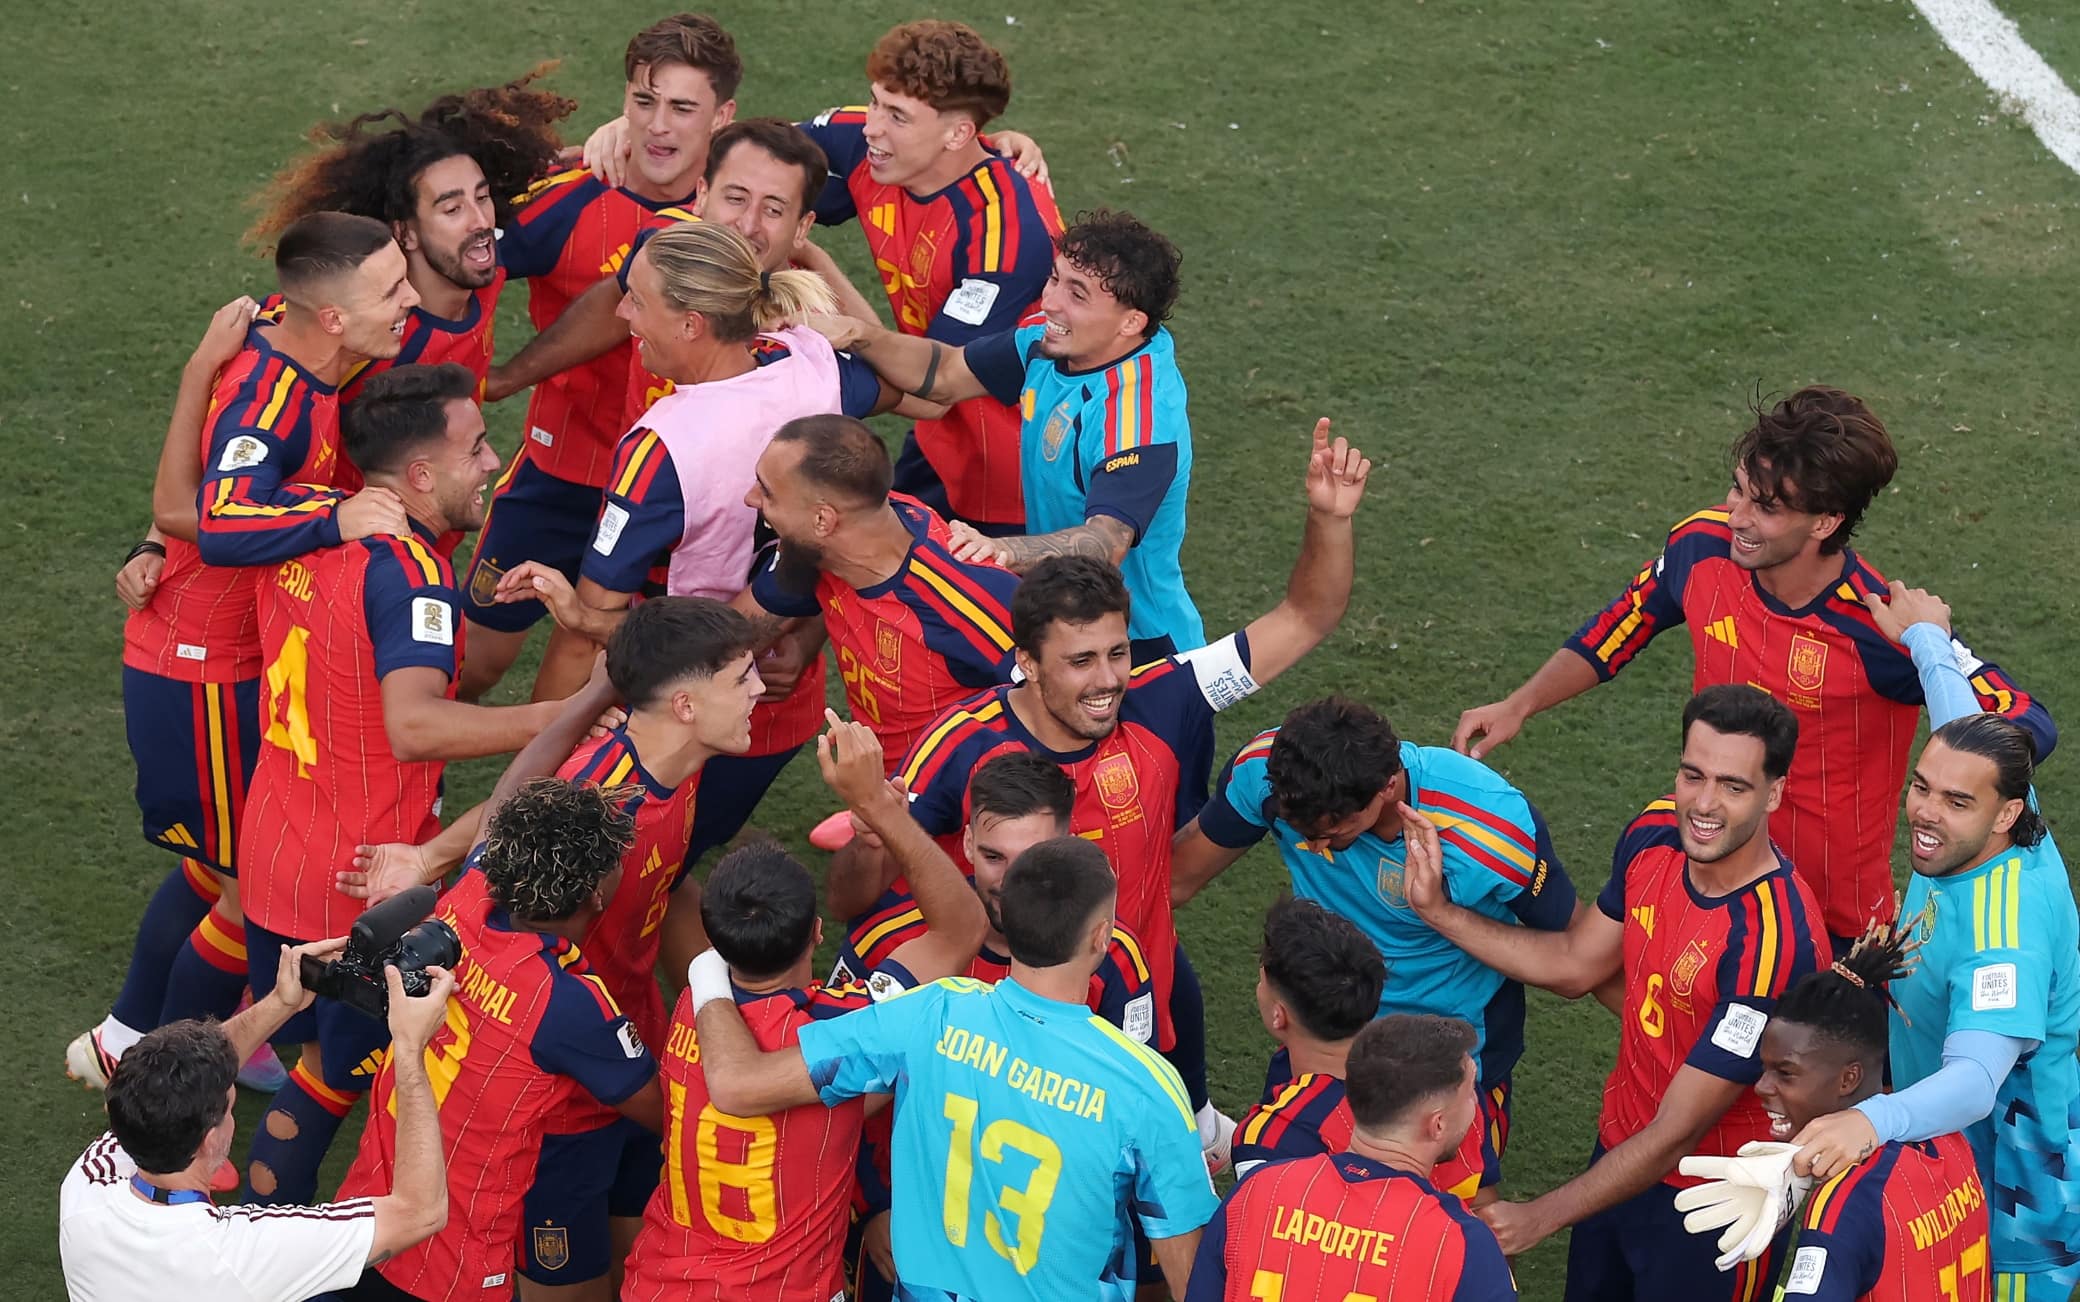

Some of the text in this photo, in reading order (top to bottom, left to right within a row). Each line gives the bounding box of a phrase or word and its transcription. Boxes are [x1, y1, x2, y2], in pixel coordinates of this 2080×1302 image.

[1105, 452, 1140, 473] ESPAÑA
[277, 560, 314, 602] ERIC
[264, 624, 318, 781] 4
[841, 646, 881, 725] 26
[460, 958, 518, 1025] YAMAL
[1639, 973, 1665, 1038] 6
[1981, 978, 2008, 990] UNITES
[1728, 1018, 1755, 1036] UNITES
[936, 1025, 1106, 1122] JOAN GARCIA
[668, 1079, 777, 1243] 18
[943, 1092, 1063, 1276] 13
[1272, 1206, 1395, 1267] LAPORTE
[1906, 1175, 1981, 1252] WILLIAMS
